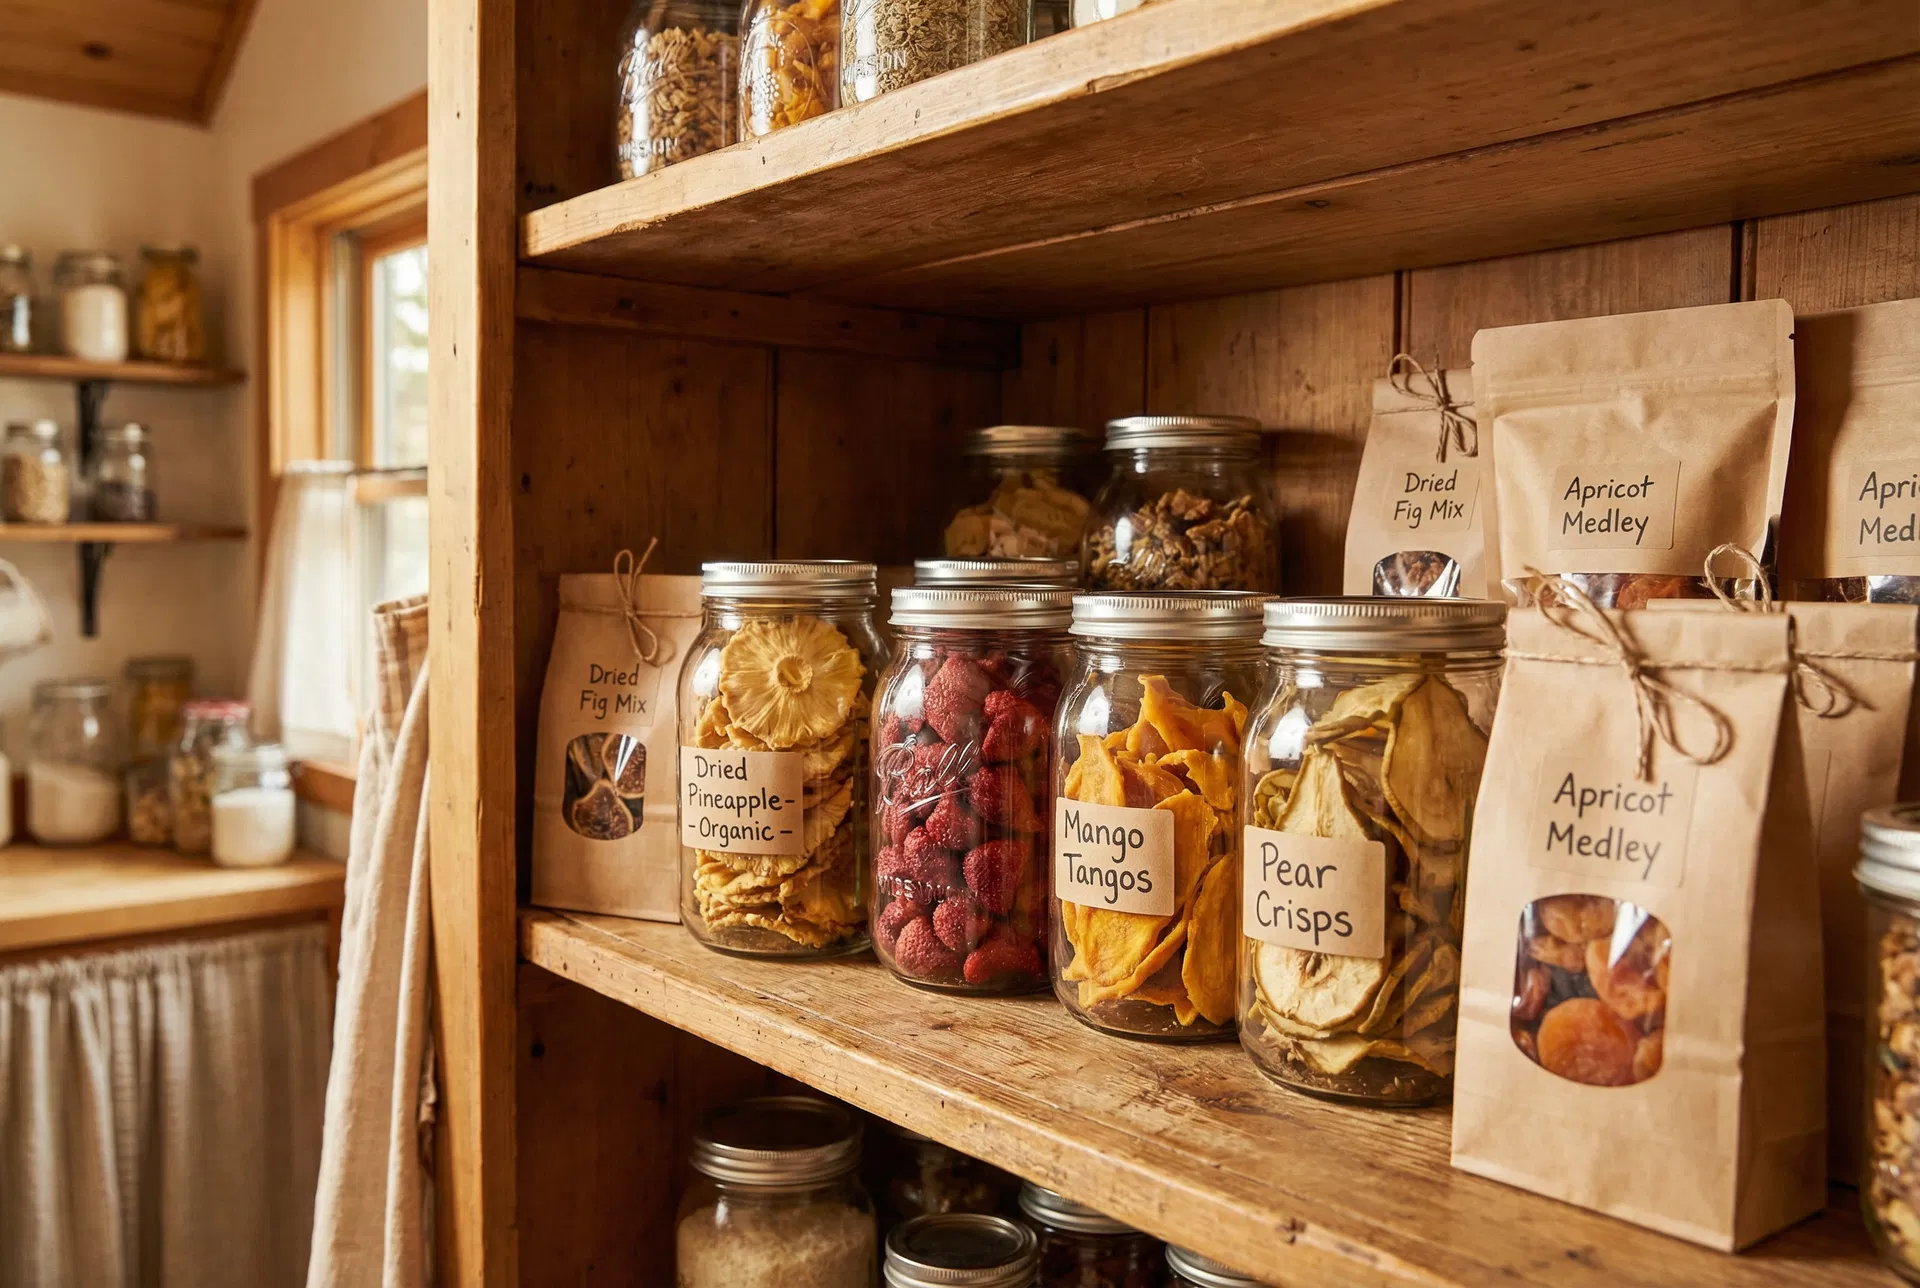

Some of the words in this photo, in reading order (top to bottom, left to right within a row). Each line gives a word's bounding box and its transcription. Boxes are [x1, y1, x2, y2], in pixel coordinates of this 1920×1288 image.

[1404, 468, 1458, 493] Dried
[1563, 474, 1655, 507] Apricot
[1858, 470, 1920, 510] Apri
[1393, 499, 1422, 530] Fig
[1429, 498, 1465, 521] Mix
[1562, 507, 1650, 546] Medley
[589, 663, 640, 688] Dried
[579, 690, 608, 720] Fig
[615, 693, 648, 715] Mix
[694, 755, 748, 782] Dried
[876, 734, 979, 815] Ball
[1552, 771, 1674, 819] Apricot
[1063, 809, 1145, 864] Mango
[1546, 820, 1662, 881] Medley
[1062, 852, 1153, 905] Tangos
[1260, 841, 1338, 890] Pear
[1255, 890, 1353, 946] Crisps
